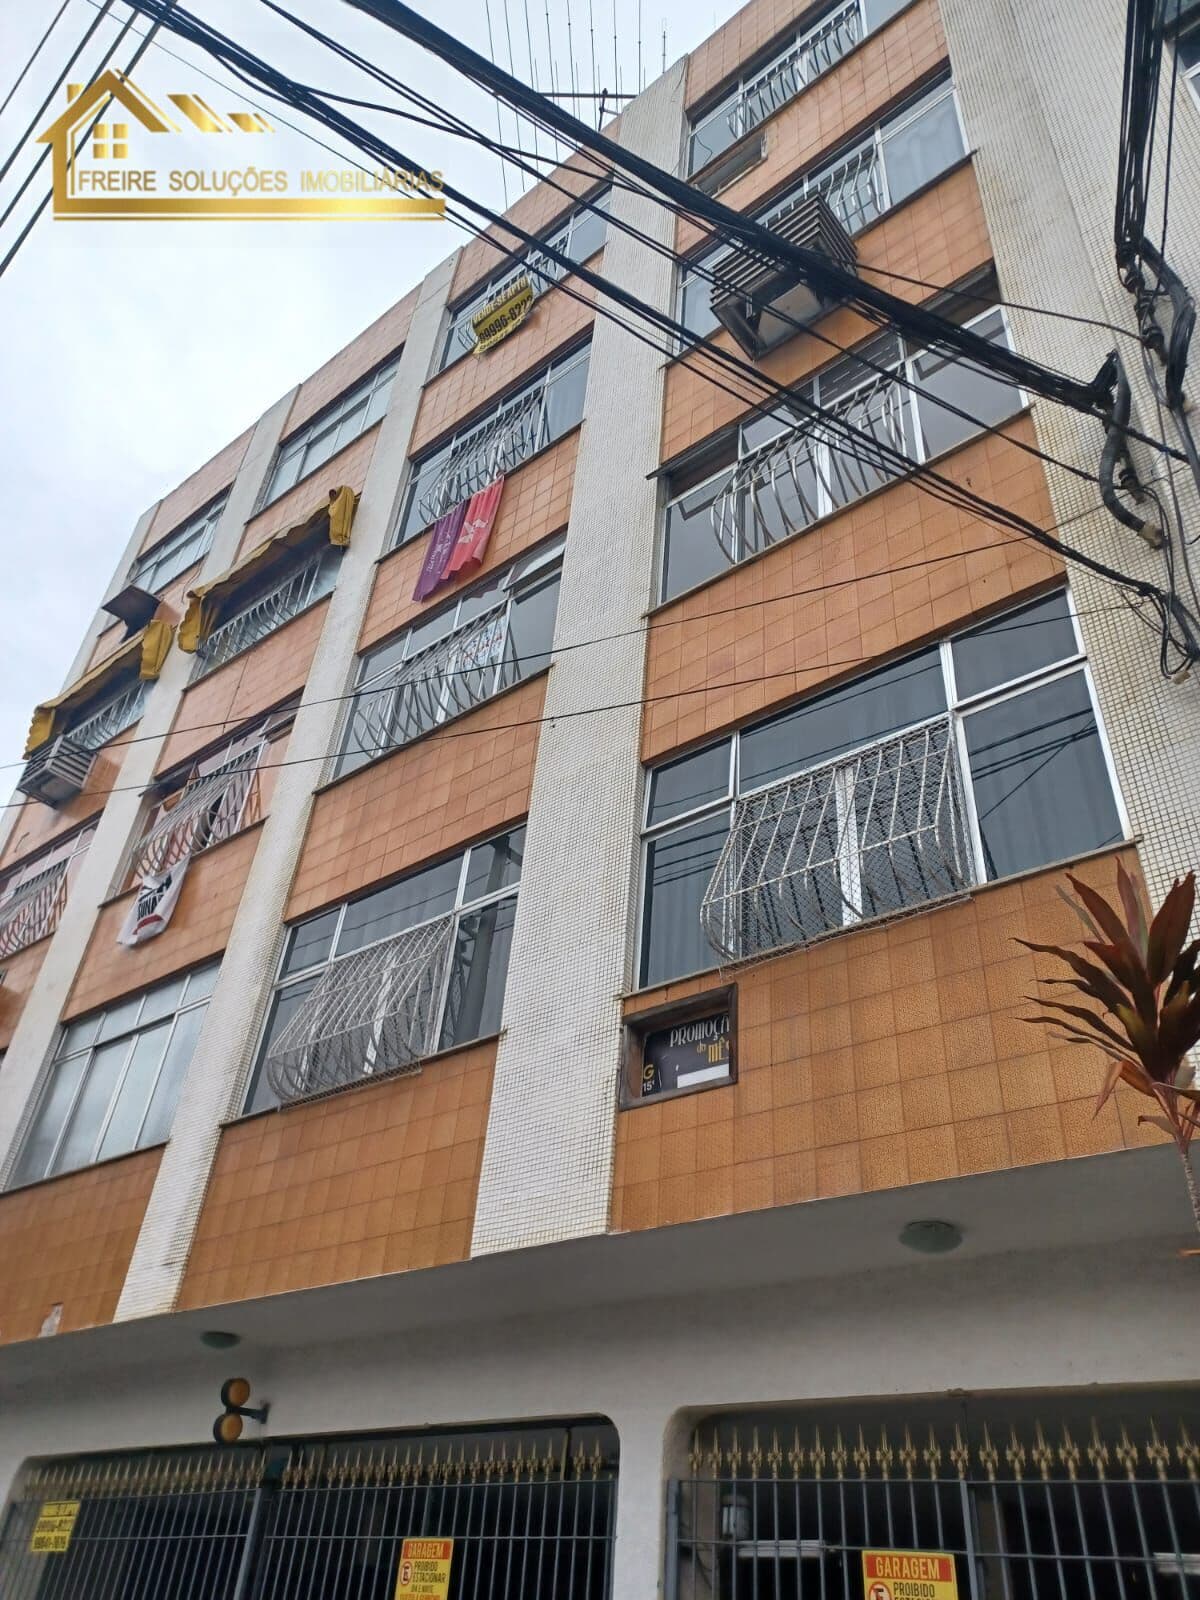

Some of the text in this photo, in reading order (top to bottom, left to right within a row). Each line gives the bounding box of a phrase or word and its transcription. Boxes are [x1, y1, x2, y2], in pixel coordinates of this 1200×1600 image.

[408, 1542, 444, 1558] GARAGEM
[875, 1556, 940, 1579] GARAGEM
[893, 1582, 936, 1598] PROIBIDO
